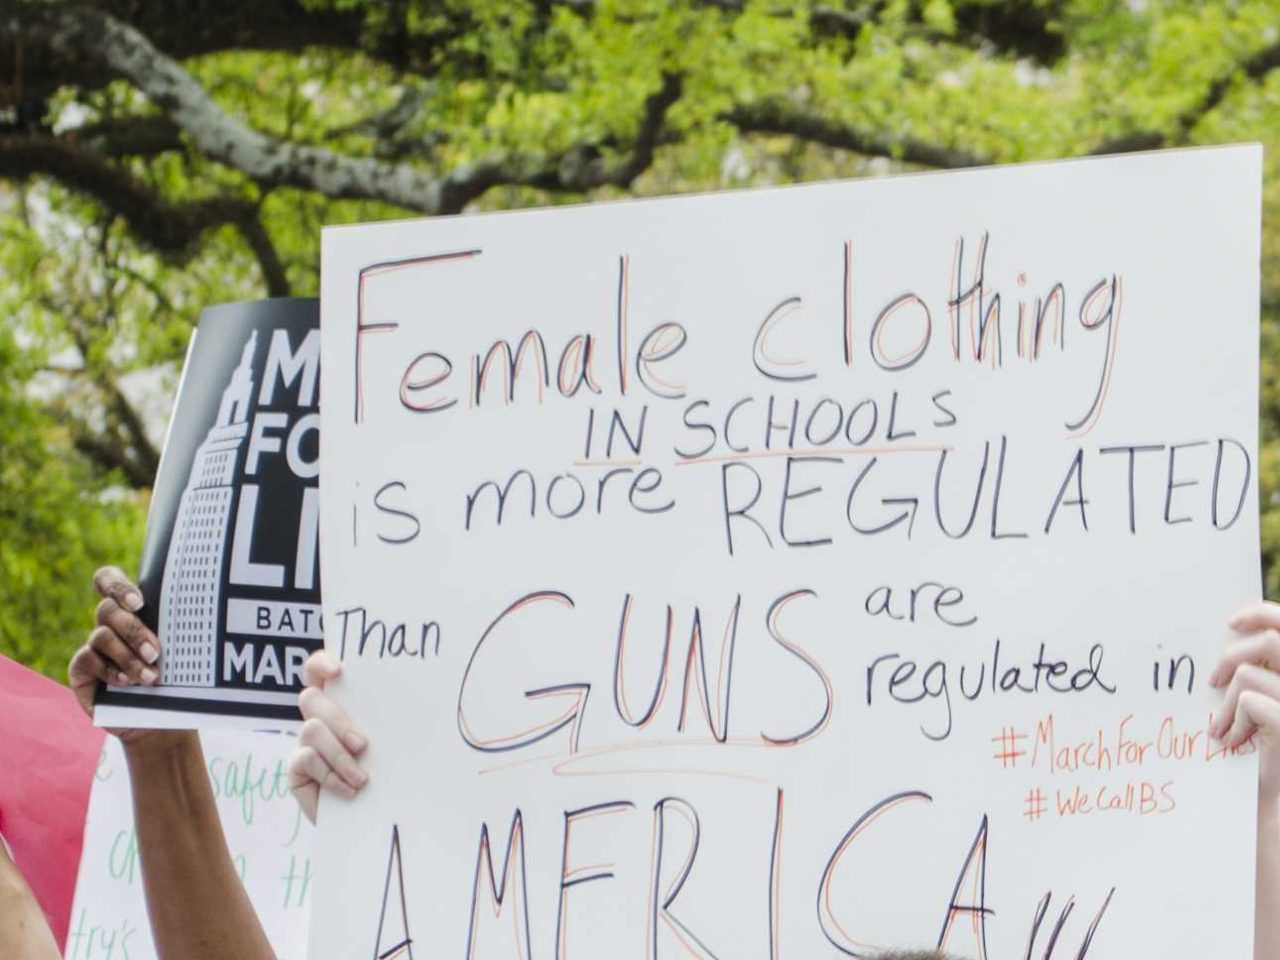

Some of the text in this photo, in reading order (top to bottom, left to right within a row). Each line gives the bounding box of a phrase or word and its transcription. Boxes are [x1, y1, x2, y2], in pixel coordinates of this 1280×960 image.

[258, 328, 320, 407] M
[355, 230, 1124, 438] Female clothing
[245, 411, 320, 479] FO
[584, 390, 959, 460] IN SCHOOLS
[229, 483, 320, 589] LI
[464, 464, 676, 535] more
[722, 436, 1251, 556] REGULATED
[223, 641, 305, 687] MAR
[256, 606, 324, 633] BAT
[456, 588, 835, 756] GUNS
[864, 581, 979, 627] are
[866, 637, 1197, 741] regulated in
